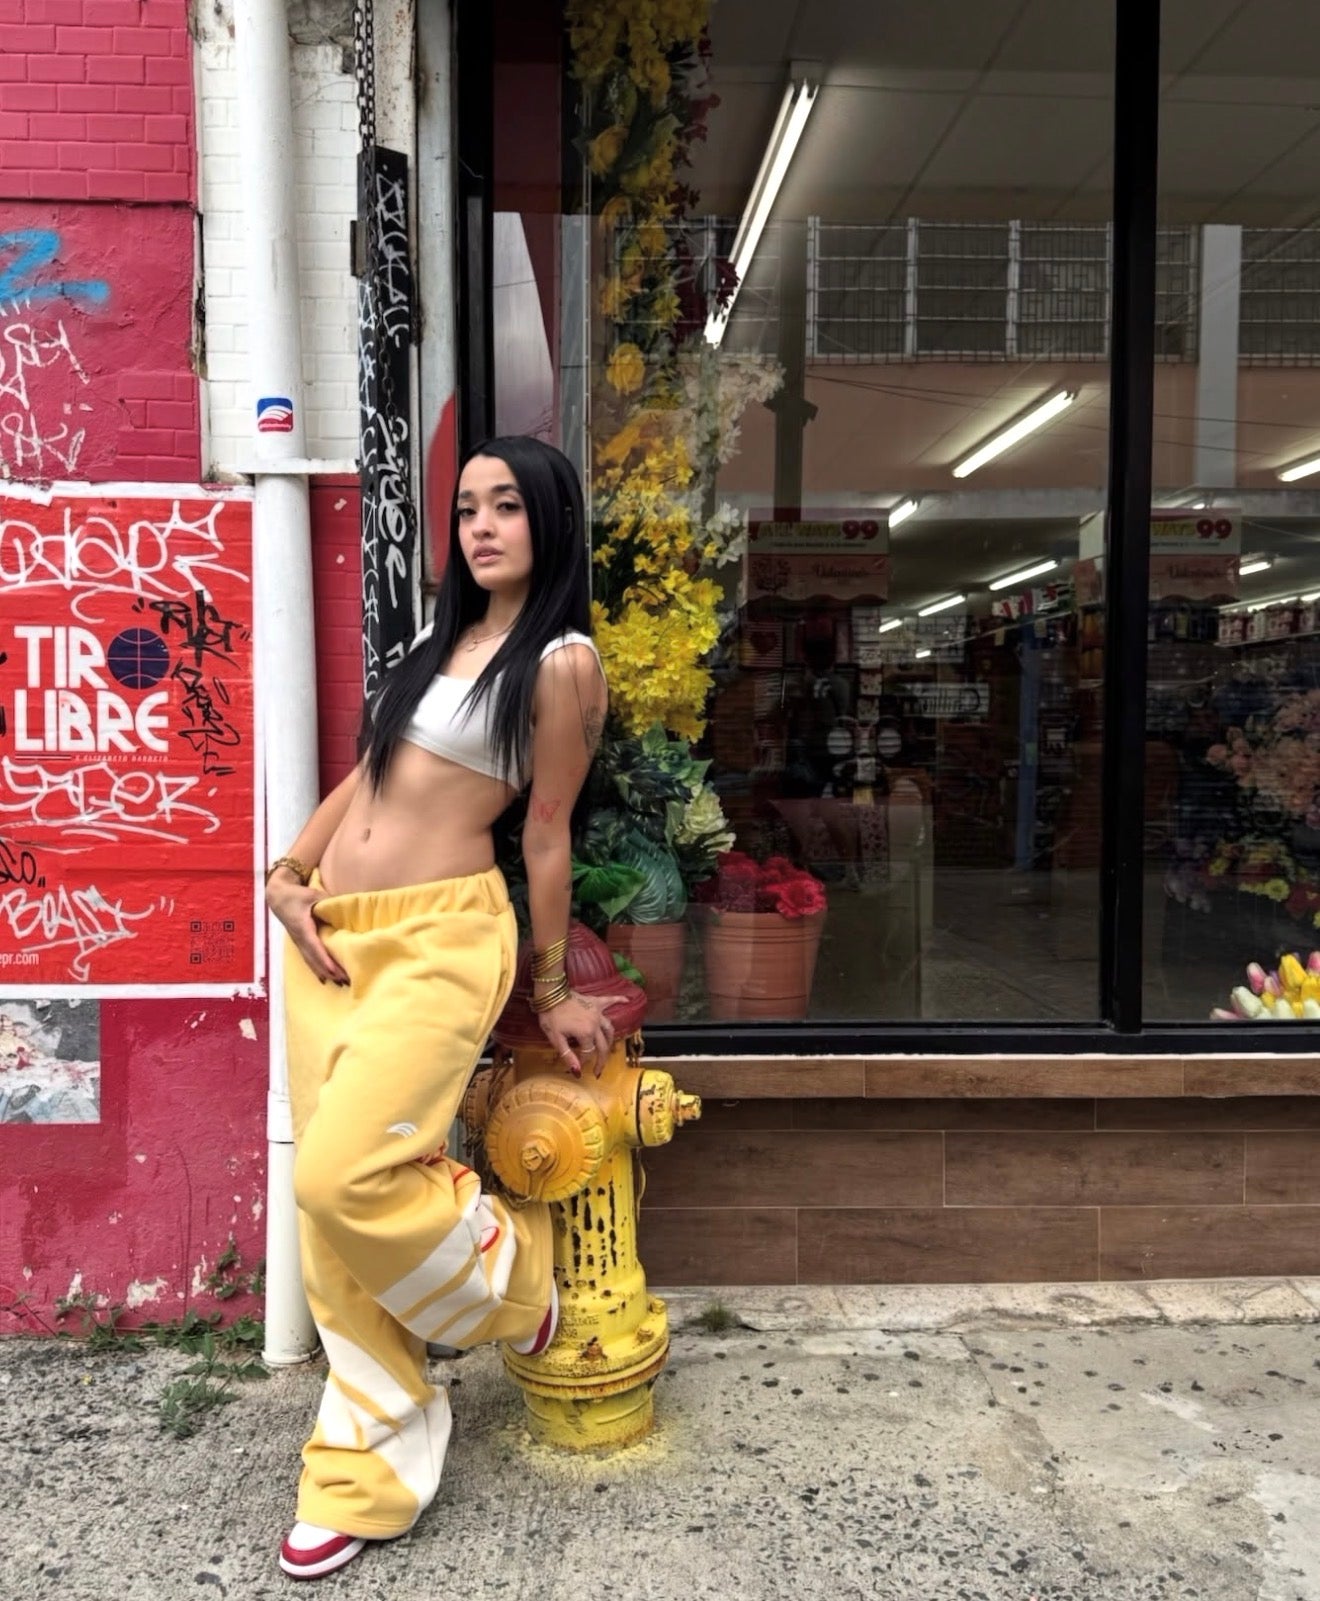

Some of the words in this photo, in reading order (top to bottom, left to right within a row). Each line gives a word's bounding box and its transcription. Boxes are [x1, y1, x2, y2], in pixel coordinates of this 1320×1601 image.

[843, 520, 879, 539] 99
[1197, 519, 1232, 539] 99
[14, 689, 169, 752] LIBRE
